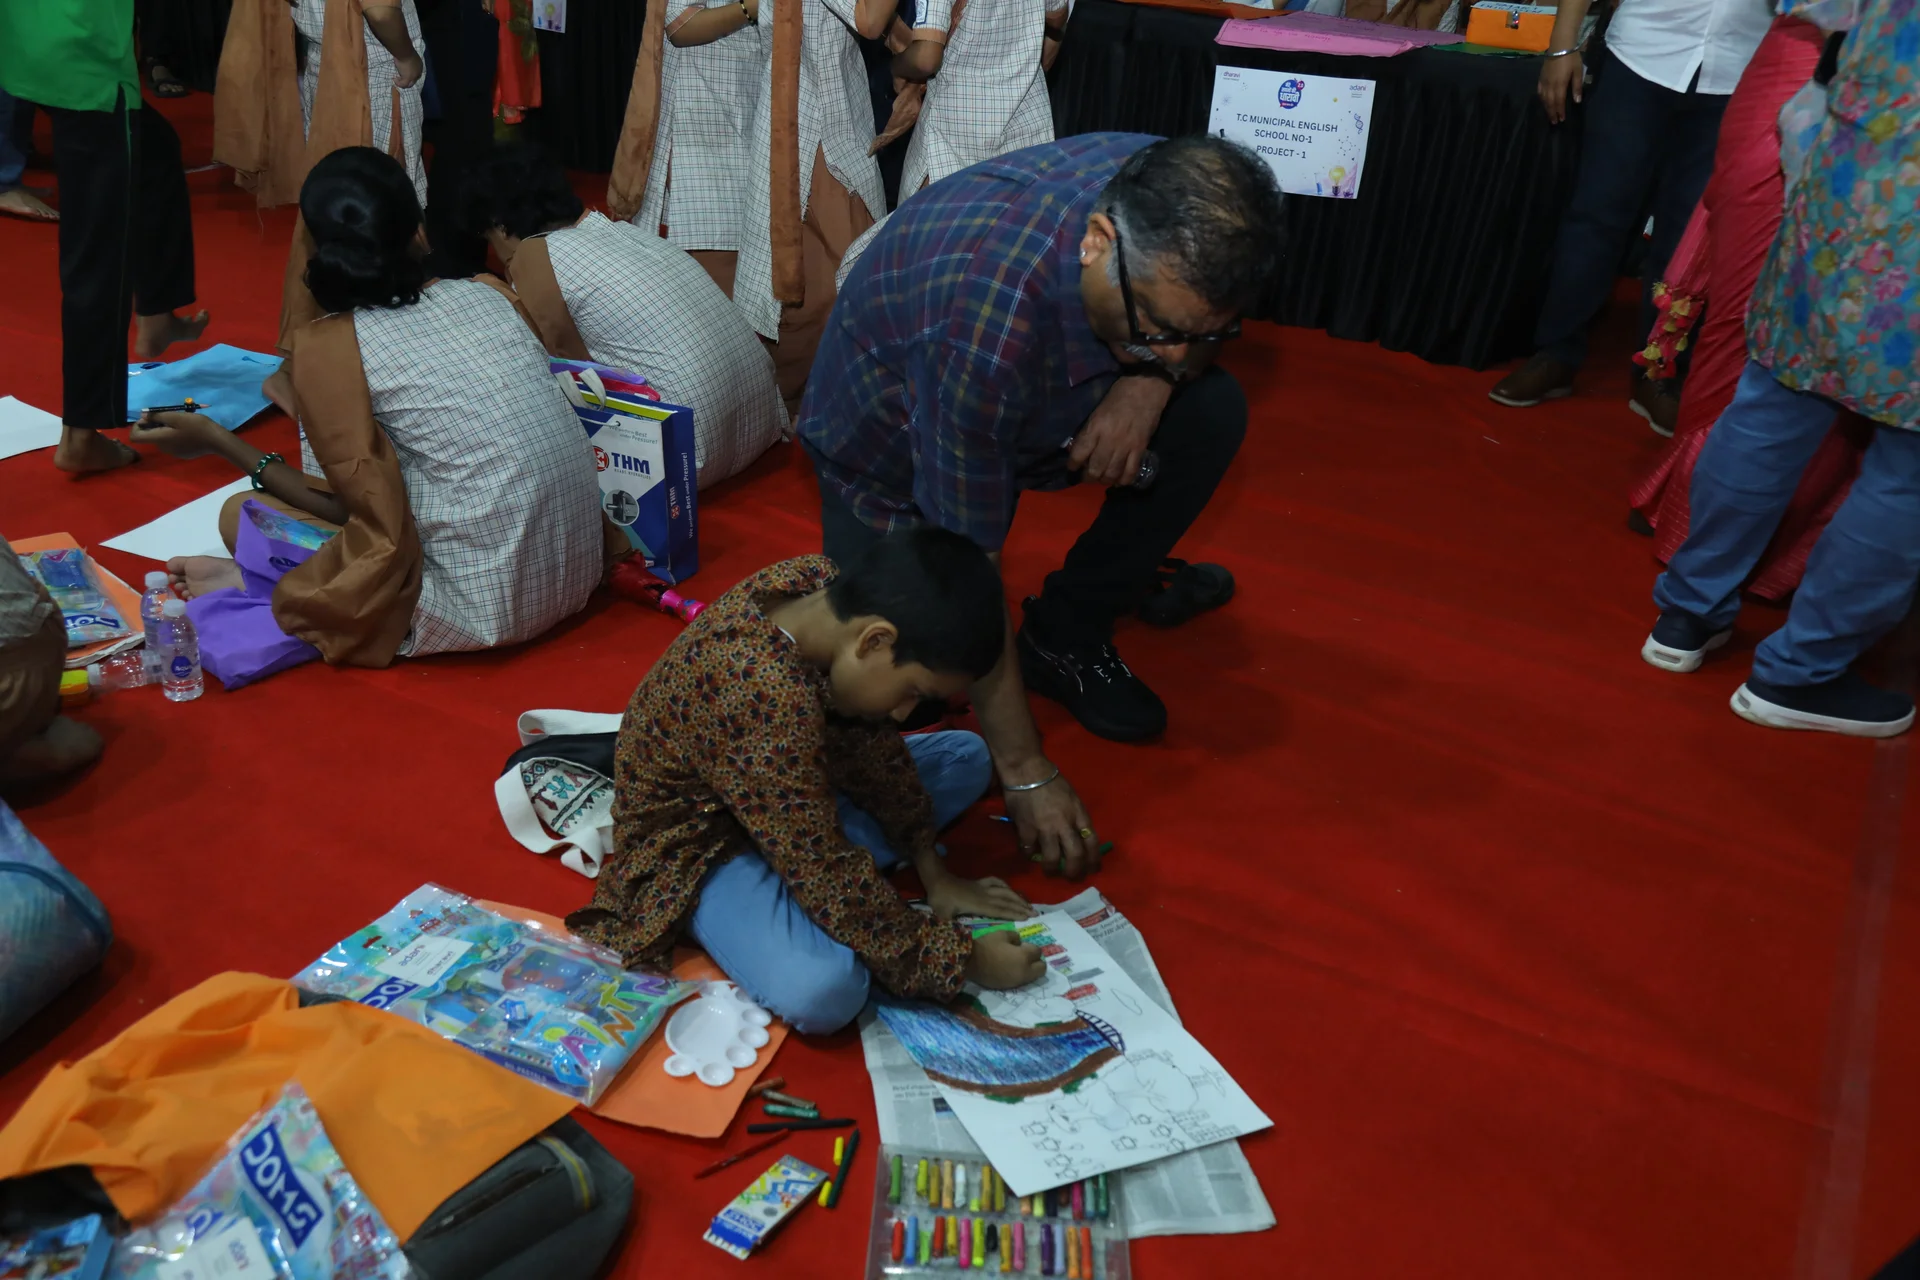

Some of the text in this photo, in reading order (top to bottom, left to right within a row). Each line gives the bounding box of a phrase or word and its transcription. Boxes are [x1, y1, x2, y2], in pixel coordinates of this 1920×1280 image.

[1236, 113, 1338, 133] T.C MUNICIPAL ENGLISH
[1254, 129, 1313, 144] SCHOOL NO-1
[1256, 146, 1294, 157] PROJECT
[632, 435, 658, 445] Pressure!
[611, 452, 650, 475] THM
[681, 452, 689, 481] Pressure!
[398, 944, 425, 968] adani
[243, 1131, 318, 1230] DOMS
